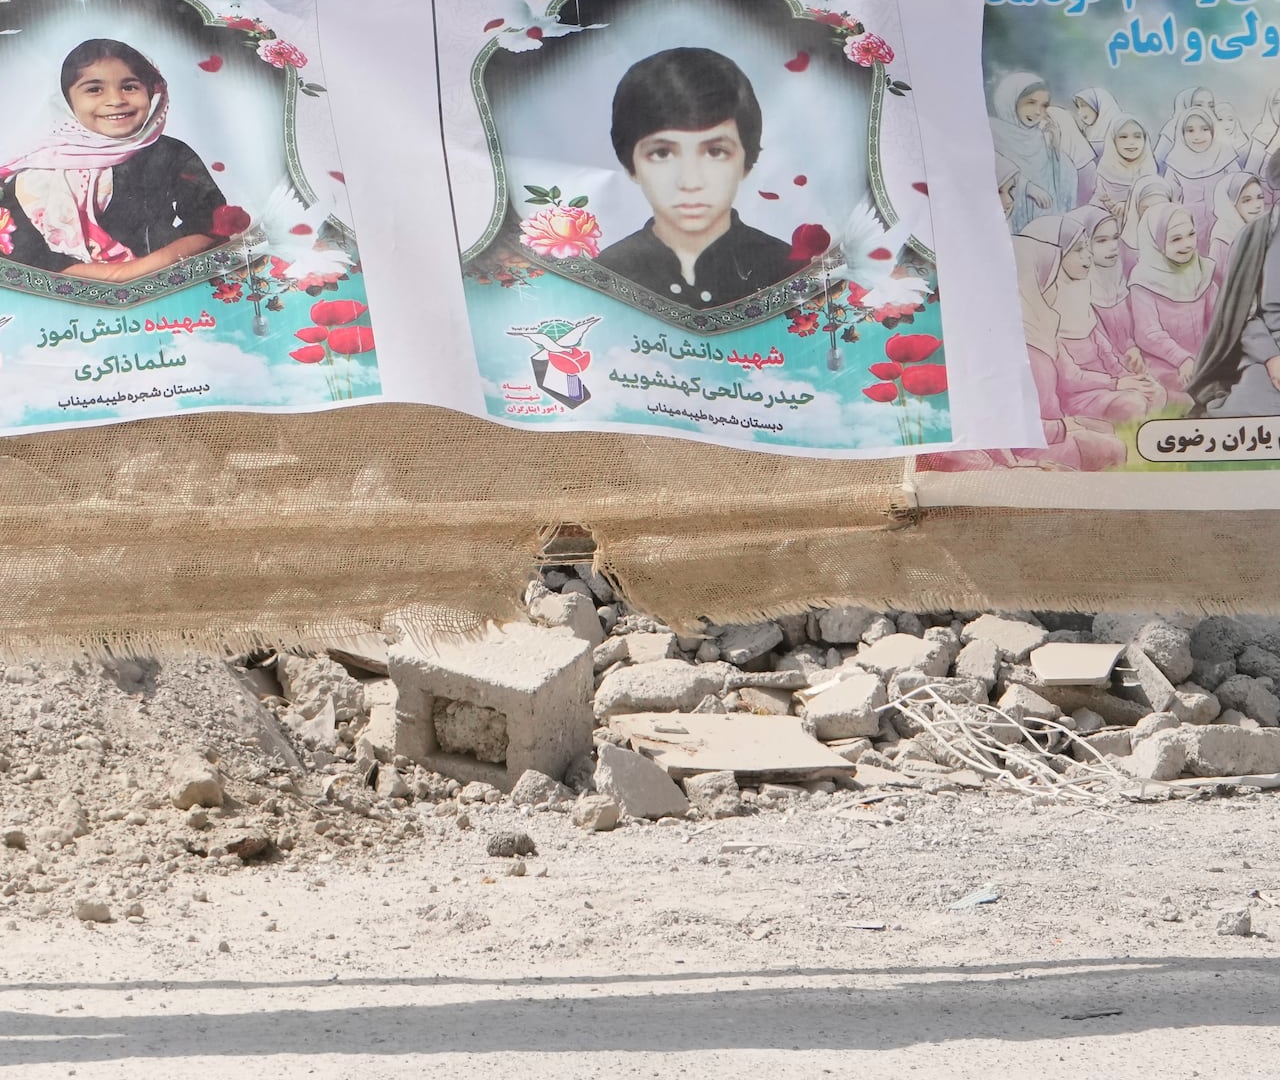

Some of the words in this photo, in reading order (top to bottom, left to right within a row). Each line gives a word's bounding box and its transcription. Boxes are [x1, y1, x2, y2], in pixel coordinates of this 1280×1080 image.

[1108, 16, 1174, 66] امام
[1183, 29, 1202, 63] و
[144, 310, 216, 334] شهیده
[75, 354, 133, 381] ذاکری
[135, 348, 187, 371] سلما
[727, 346, 785, 369] شهید
[98, 392, 127, 405] طیبه
[127, 388, 161, 403] شجره
[164, 384, 210, 398] دبستان
[703, 383, 763, 402] صالحی
[764, 388, 814, 409] حیدر
[58, 396, 99, 410] میناب
[647, 403, 682, 416] میناب
[681, 409, 708, 422] طیبه
[709, 413, 739, 426] شجره
[740, 418, 784, 435] دبستان
[1157, 428, 1216, 453] رضوی
[1222, 425, 1272, 451] یاران
